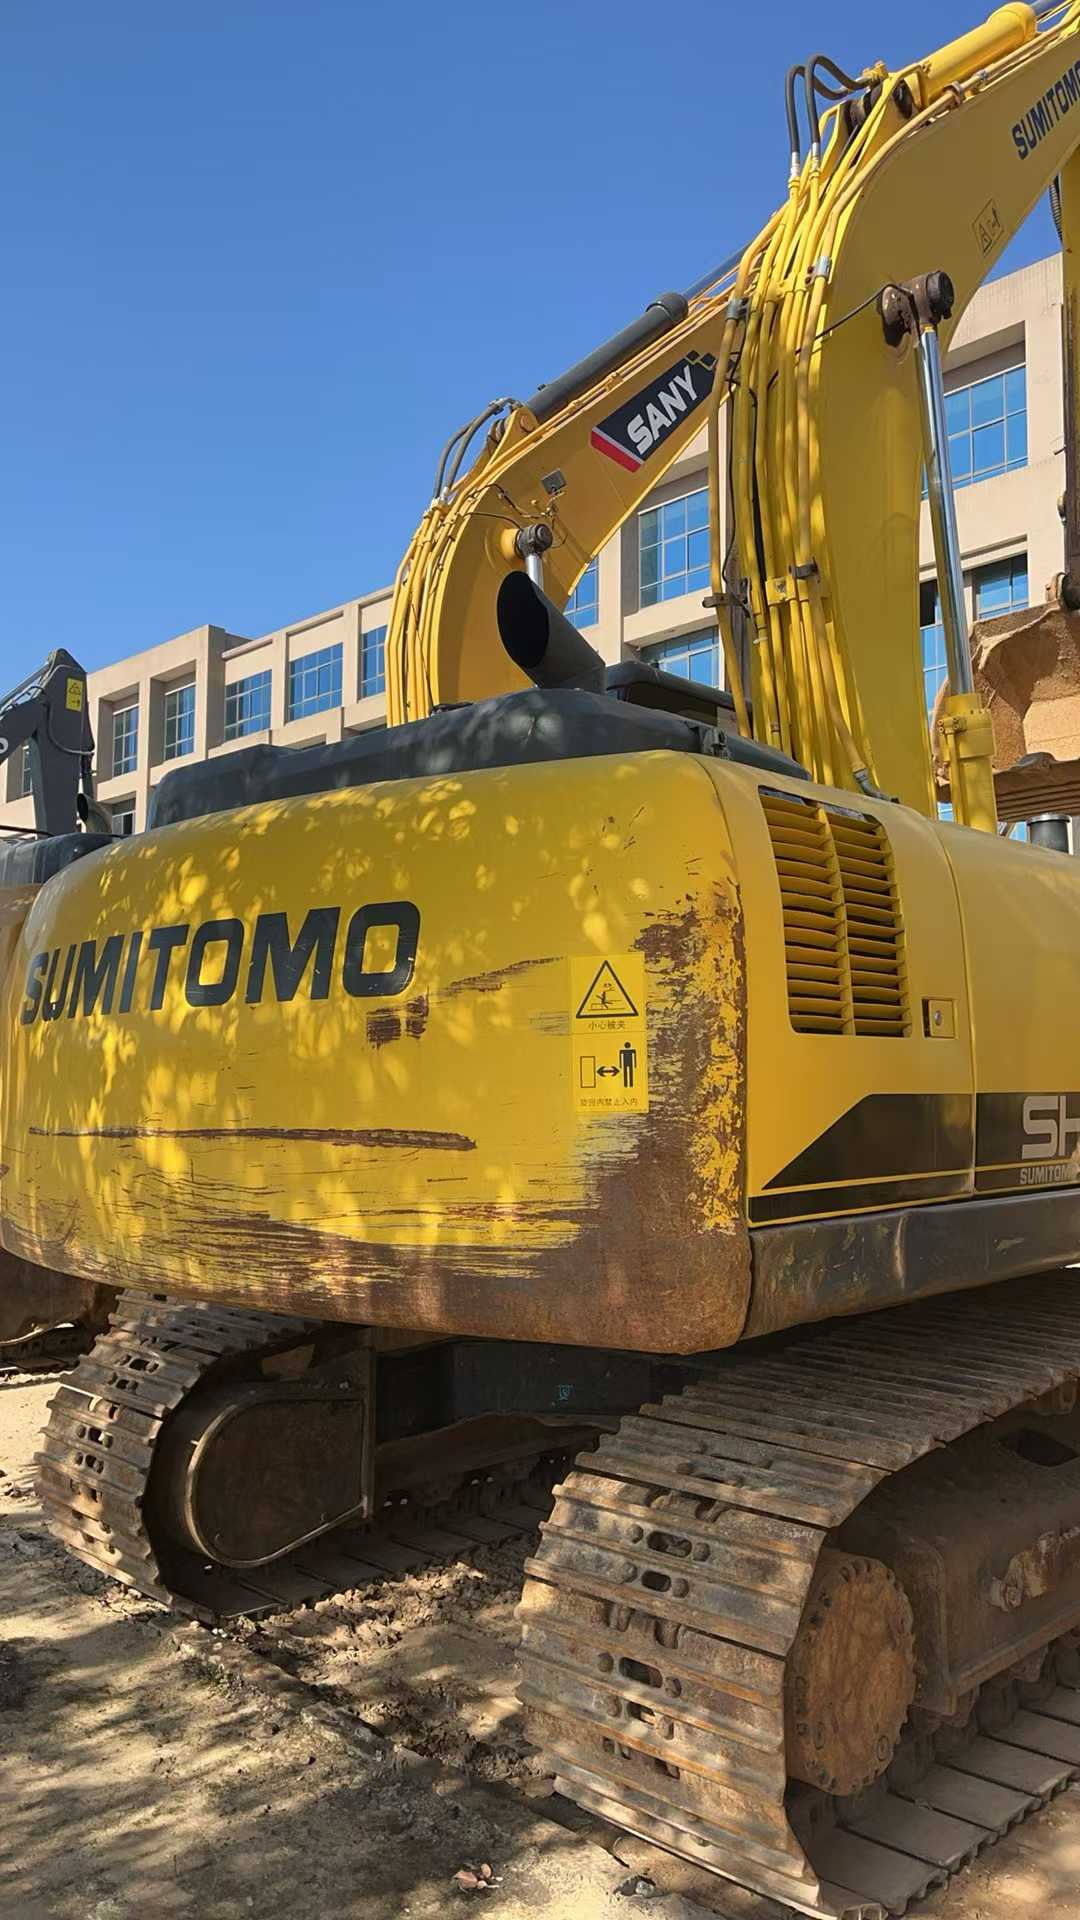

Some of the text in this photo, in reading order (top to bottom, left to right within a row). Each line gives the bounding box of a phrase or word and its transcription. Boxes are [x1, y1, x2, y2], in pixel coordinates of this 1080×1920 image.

[627, 365, 698, 455] SANY
[20, 901, 421, 1026] SUMITOMO
[1020, 1164, 1080, 1185] SUMITOM
